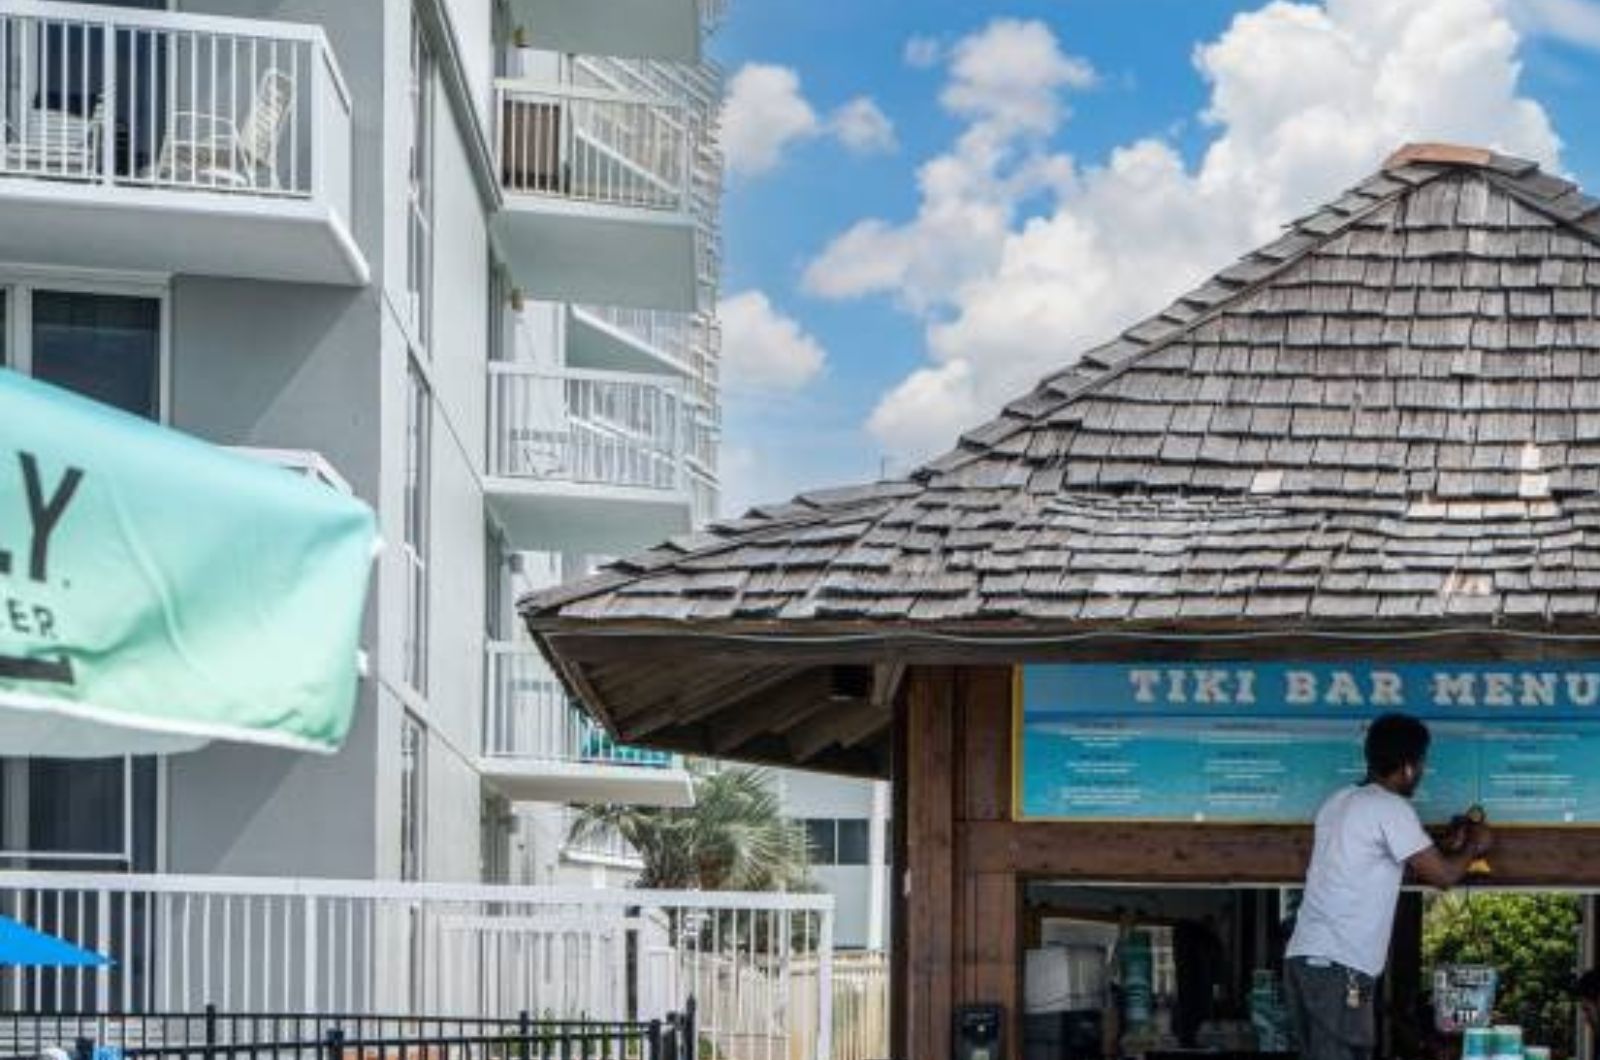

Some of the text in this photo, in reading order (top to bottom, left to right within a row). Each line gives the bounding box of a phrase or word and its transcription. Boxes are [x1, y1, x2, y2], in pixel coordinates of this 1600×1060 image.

[1129, 669, 1256, 703] TIKI
[1285, 671, 1402, 704] BAR
[1432, 672, 1600, 706] MENU
